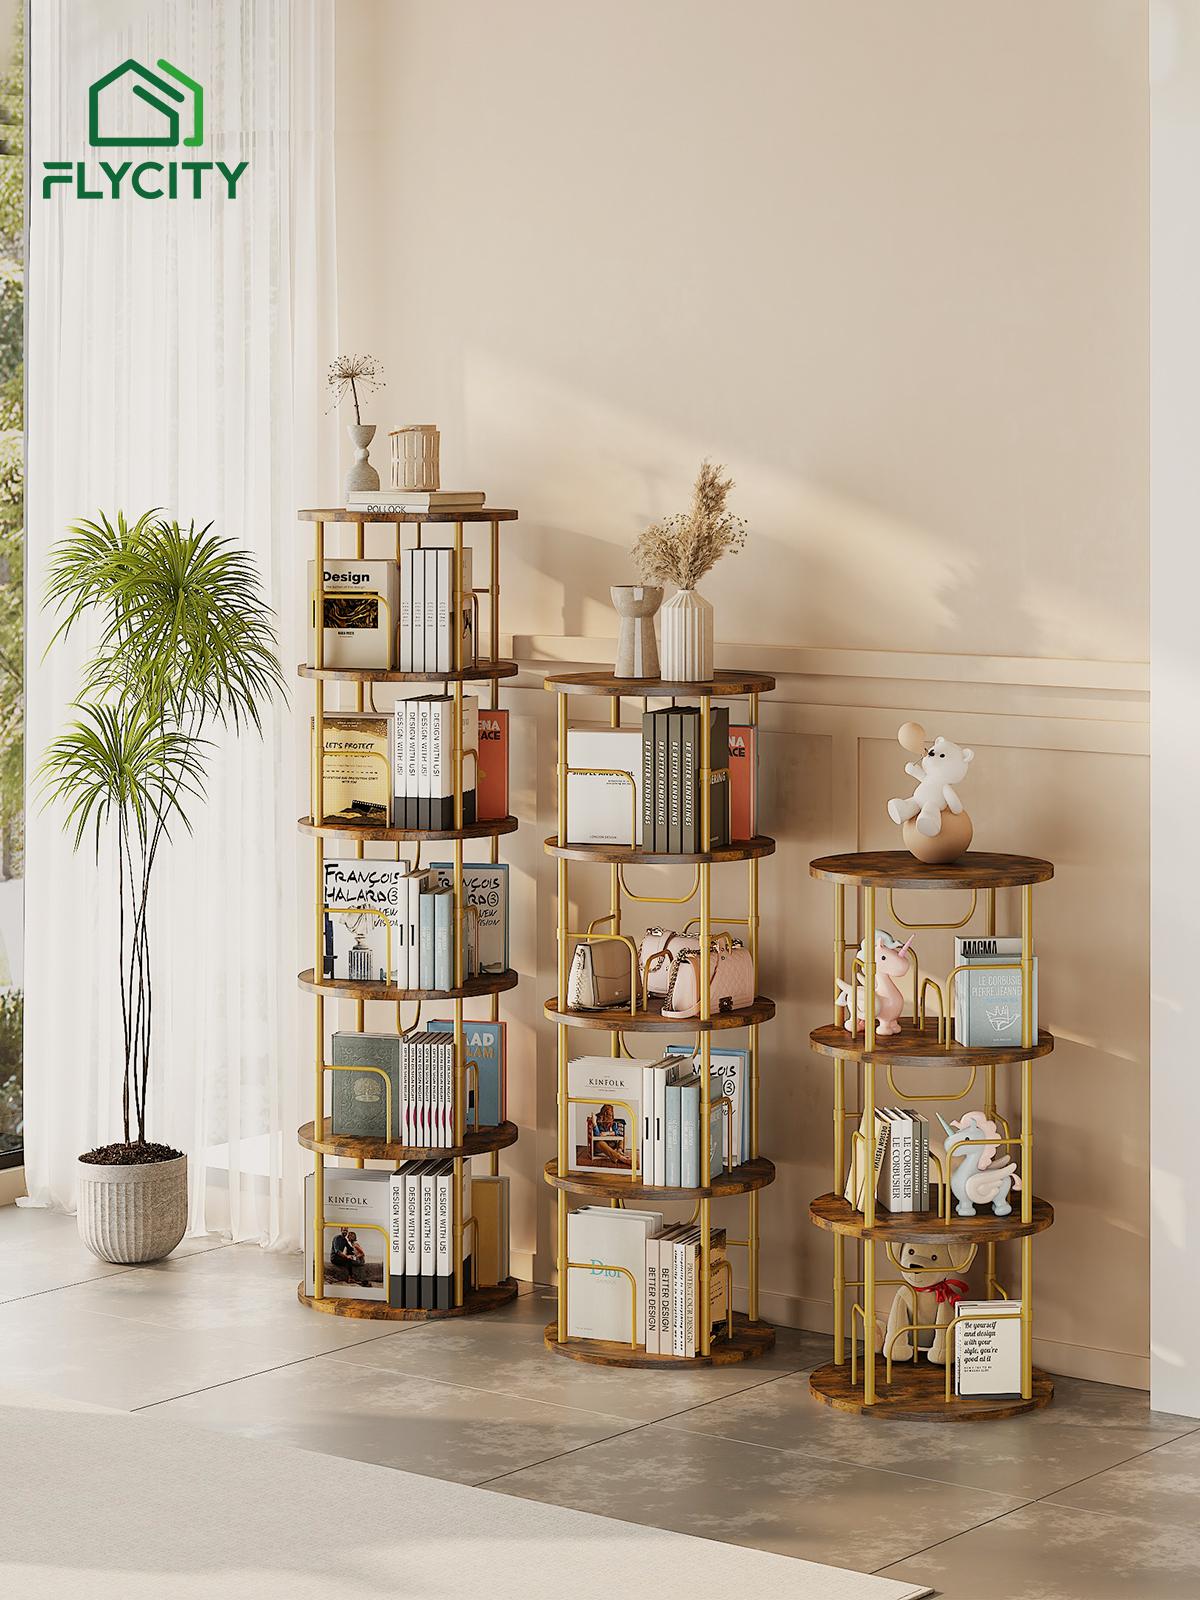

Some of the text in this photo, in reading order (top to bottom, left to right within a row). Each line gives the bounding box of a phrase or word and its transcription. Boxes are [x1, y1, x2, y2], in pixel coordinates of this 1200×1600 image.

[324, 572, 370, 584] Design
[480, 731, 500, 740] ACE
[645, 741, 651, 750] BE
[658, 741, 665, 750] BE
[672, 741, 678, 750] BE
[685, 742, 692, 751] BE
[324, 864, 400, 888] FRANÇOIS
[325, 886, 386, 902] HALARD
[963, 941, 997, 955] MAGMA
[988, 976, 1021, 986] CORBUSIE
[466, 1032, 495, 1047] AD
[589, 1078, 624, 1087] KINFOLK
[878, 1126, 887, 1147] DESIGN
[892, 1137, 900, 1148] LE
[903, 1136, 911, 1147] LE
[328, 1196, 368, 1205] KINFOLK
[973, 1321, 997, 1330] yourself
[977, 1330, 996, 1338] design
[964, 1356, 978, 1364] good
